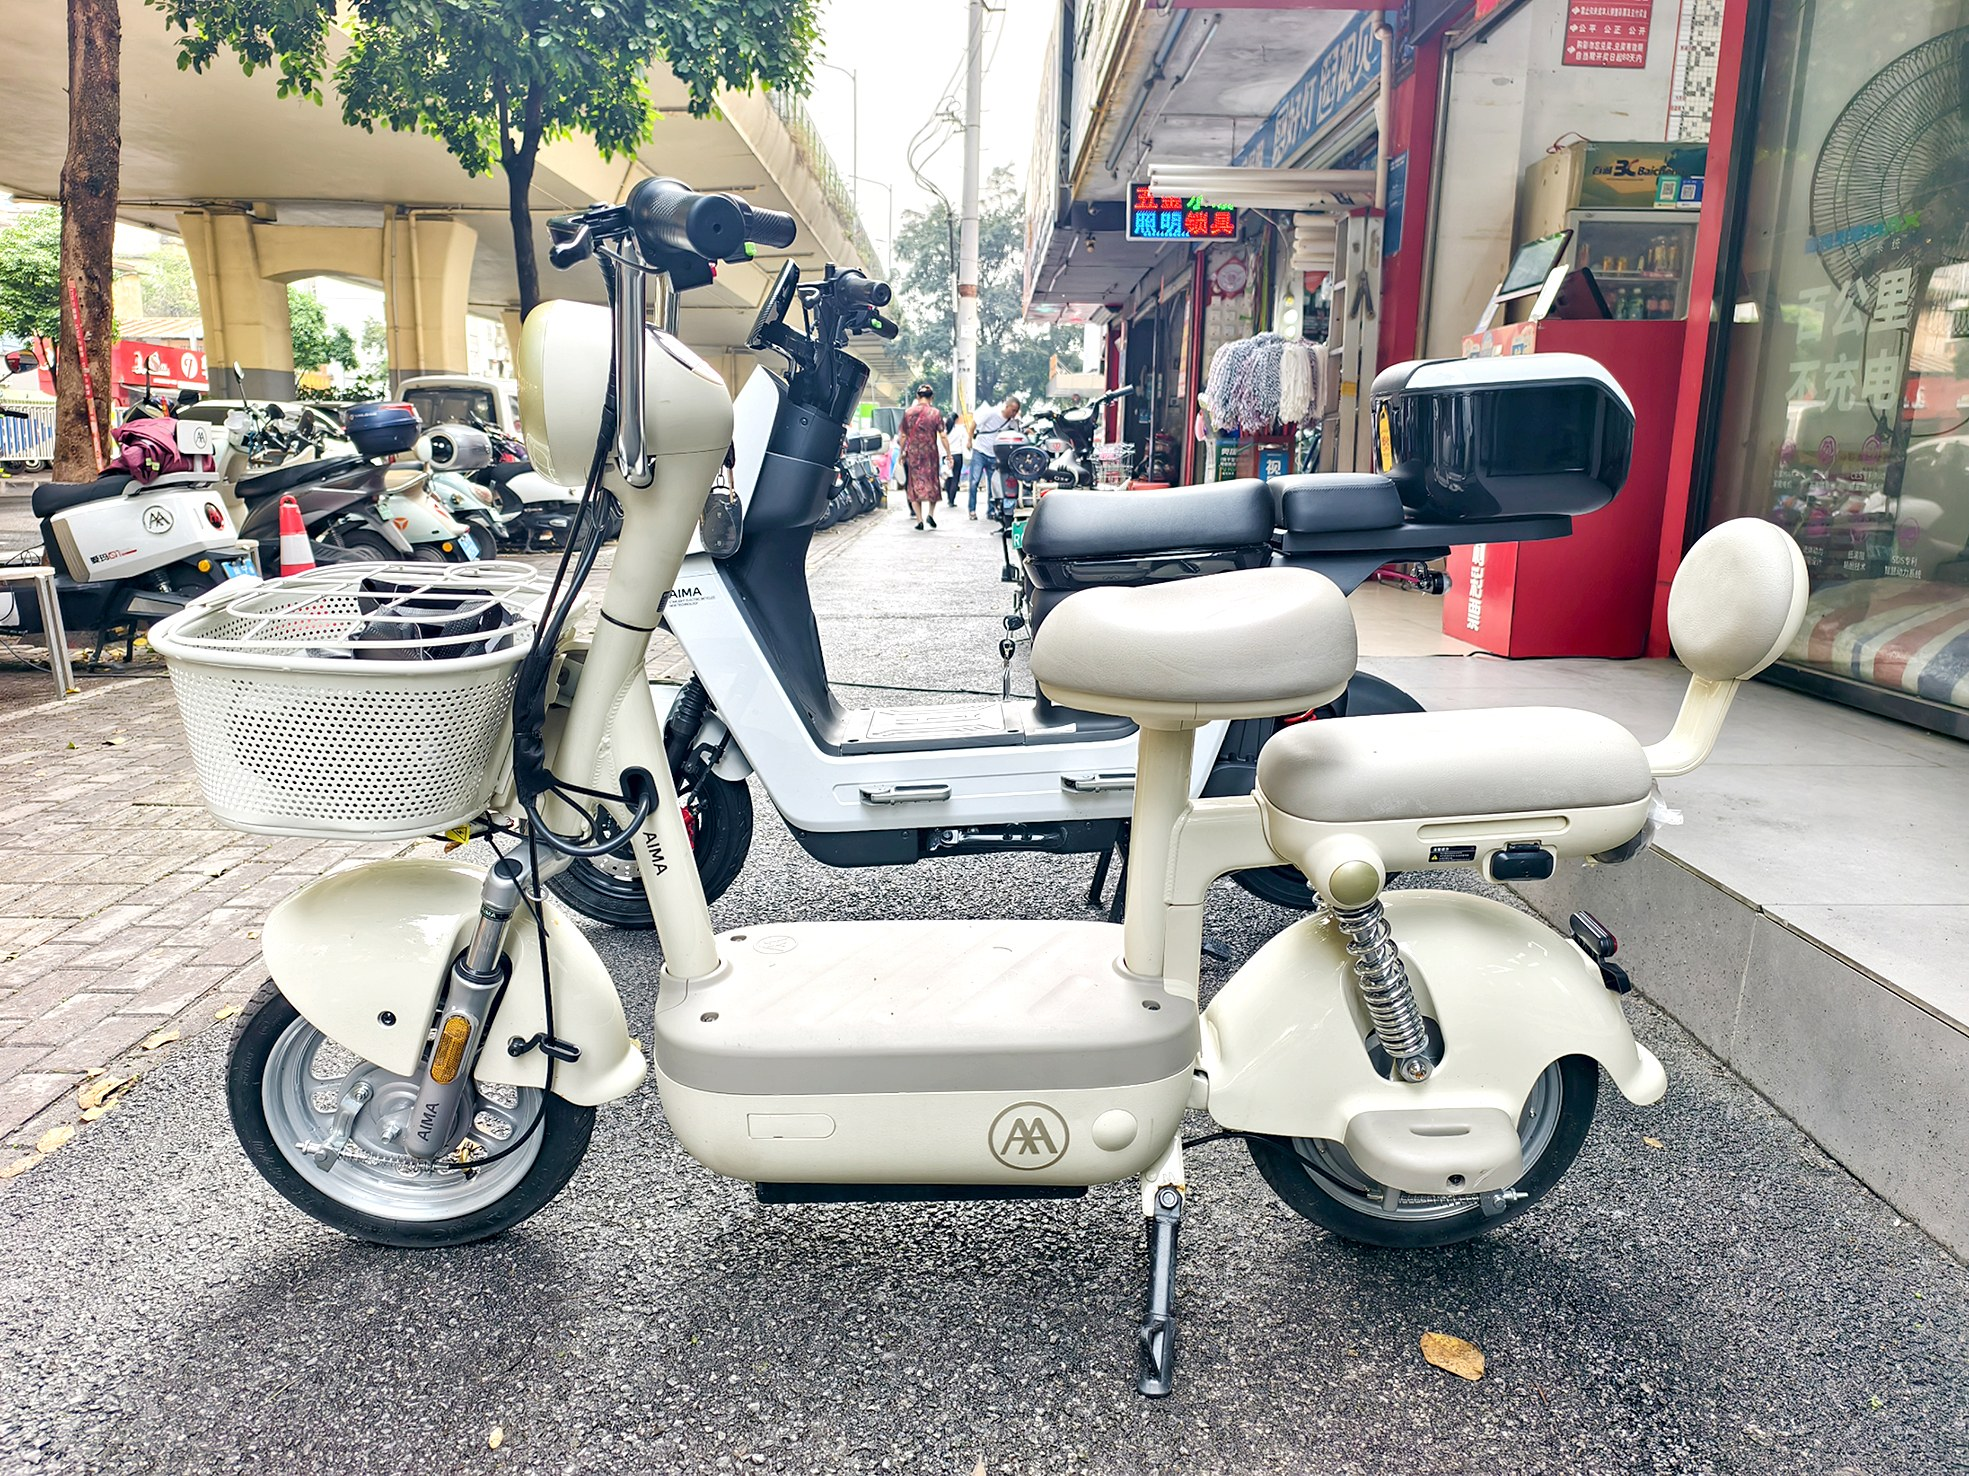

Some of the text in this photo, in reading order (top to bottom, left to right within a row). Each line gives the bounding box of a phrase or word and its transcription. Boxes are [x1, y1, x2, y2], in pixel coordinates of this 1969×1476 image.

[1578, 24, 1647, 36] 公平 公正 公开
[1786, 348, 1899, 412] 不充电
[669, 587, 702, 598] AIMA
[643, 832, 668, 876] AIMA
[417, 1103, 440, 1142] AIMA
